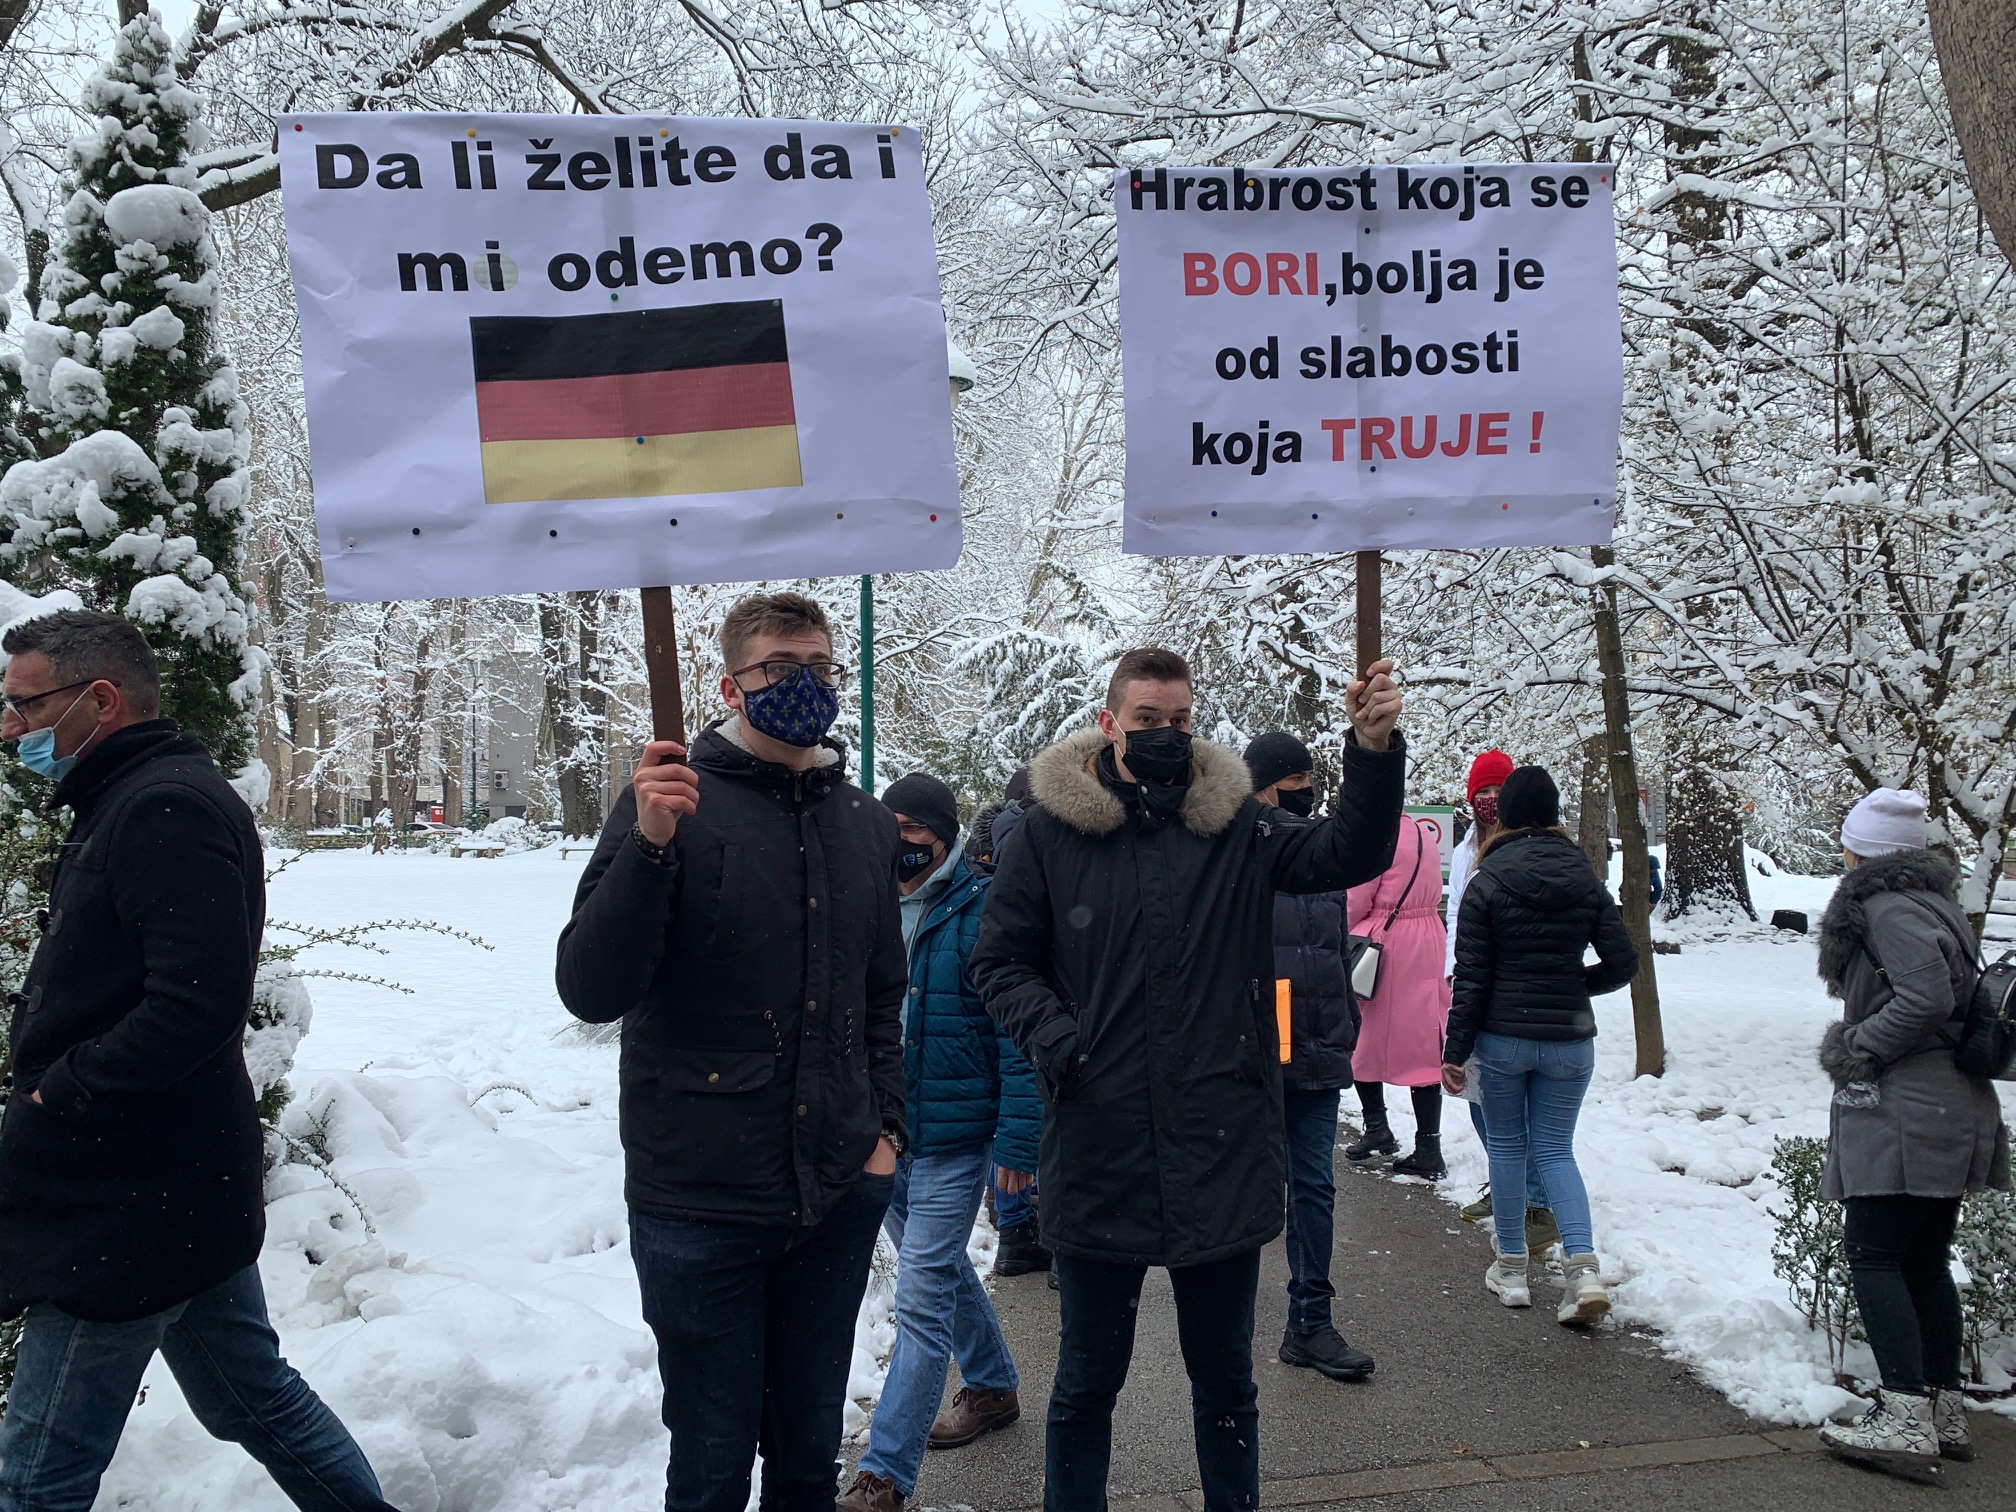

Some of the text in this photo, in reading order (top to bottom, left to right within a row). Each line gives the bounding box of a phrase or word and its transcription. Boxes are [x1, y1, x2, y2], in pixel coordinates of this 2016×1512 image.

[315, 132, 896, 191] Da li želite da i
[1130, 166, 1590, 222] Hrabrost koja se
[397, 222, 843, 292] mi odemo?
[1493, 247, 1545, 303] je
[1215, 329, 1519, 381] od slabosti
[1191, 419, 1302, 476] koja
